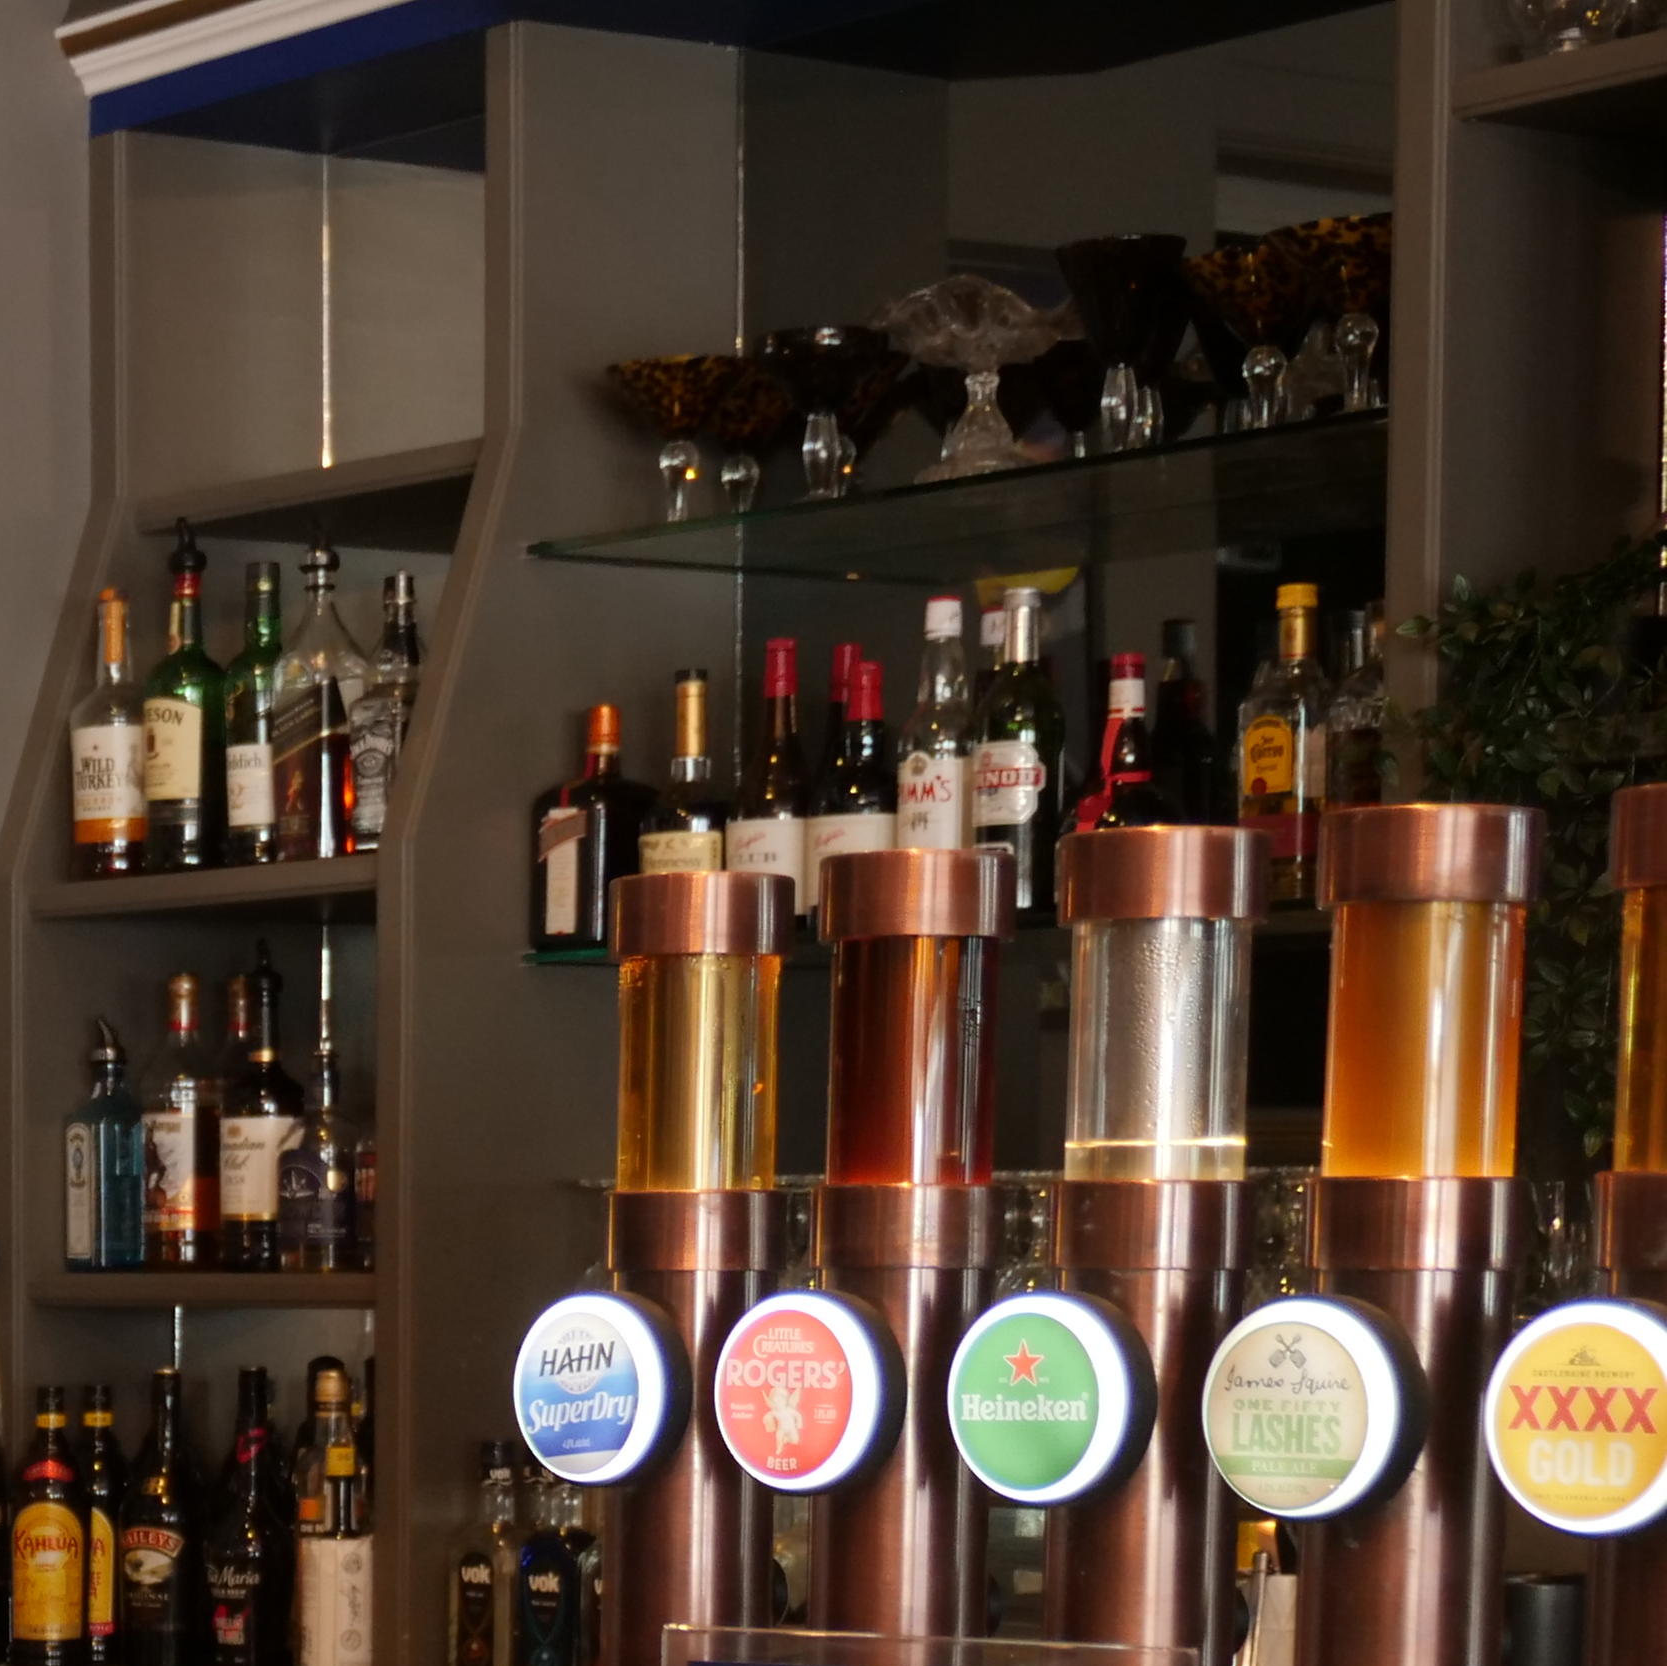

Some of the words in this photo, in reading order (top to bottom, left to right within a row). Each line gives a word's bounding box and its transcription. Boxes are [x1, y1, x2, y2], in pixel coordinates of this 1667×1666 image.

[80, 756, 115, 773] WILD
[75, 770, 122, 791] TURKEY
[539, 1340, 615, 1377] HAHN
[1224, 1364, 1285, 1392] James
[1290, 1368, 1351, 1395] Squire
[526, 1391, 634, 1435] SuperDry
[961, 1394, 1089, 1422] Heineken
[1233, 1398, 1273, 1411] ONE
[1281, 1400, 1342, 1413] FIFTY
[1508, 1385, 1659, 1434] XXXX
[1232, 1412, 1342, 1455] LASHES
[766, 1456, 797, 1471] BEER
[1527, 1437, 1635, 1488] GOLD
[218, 1565, 261, 1586] Maria
